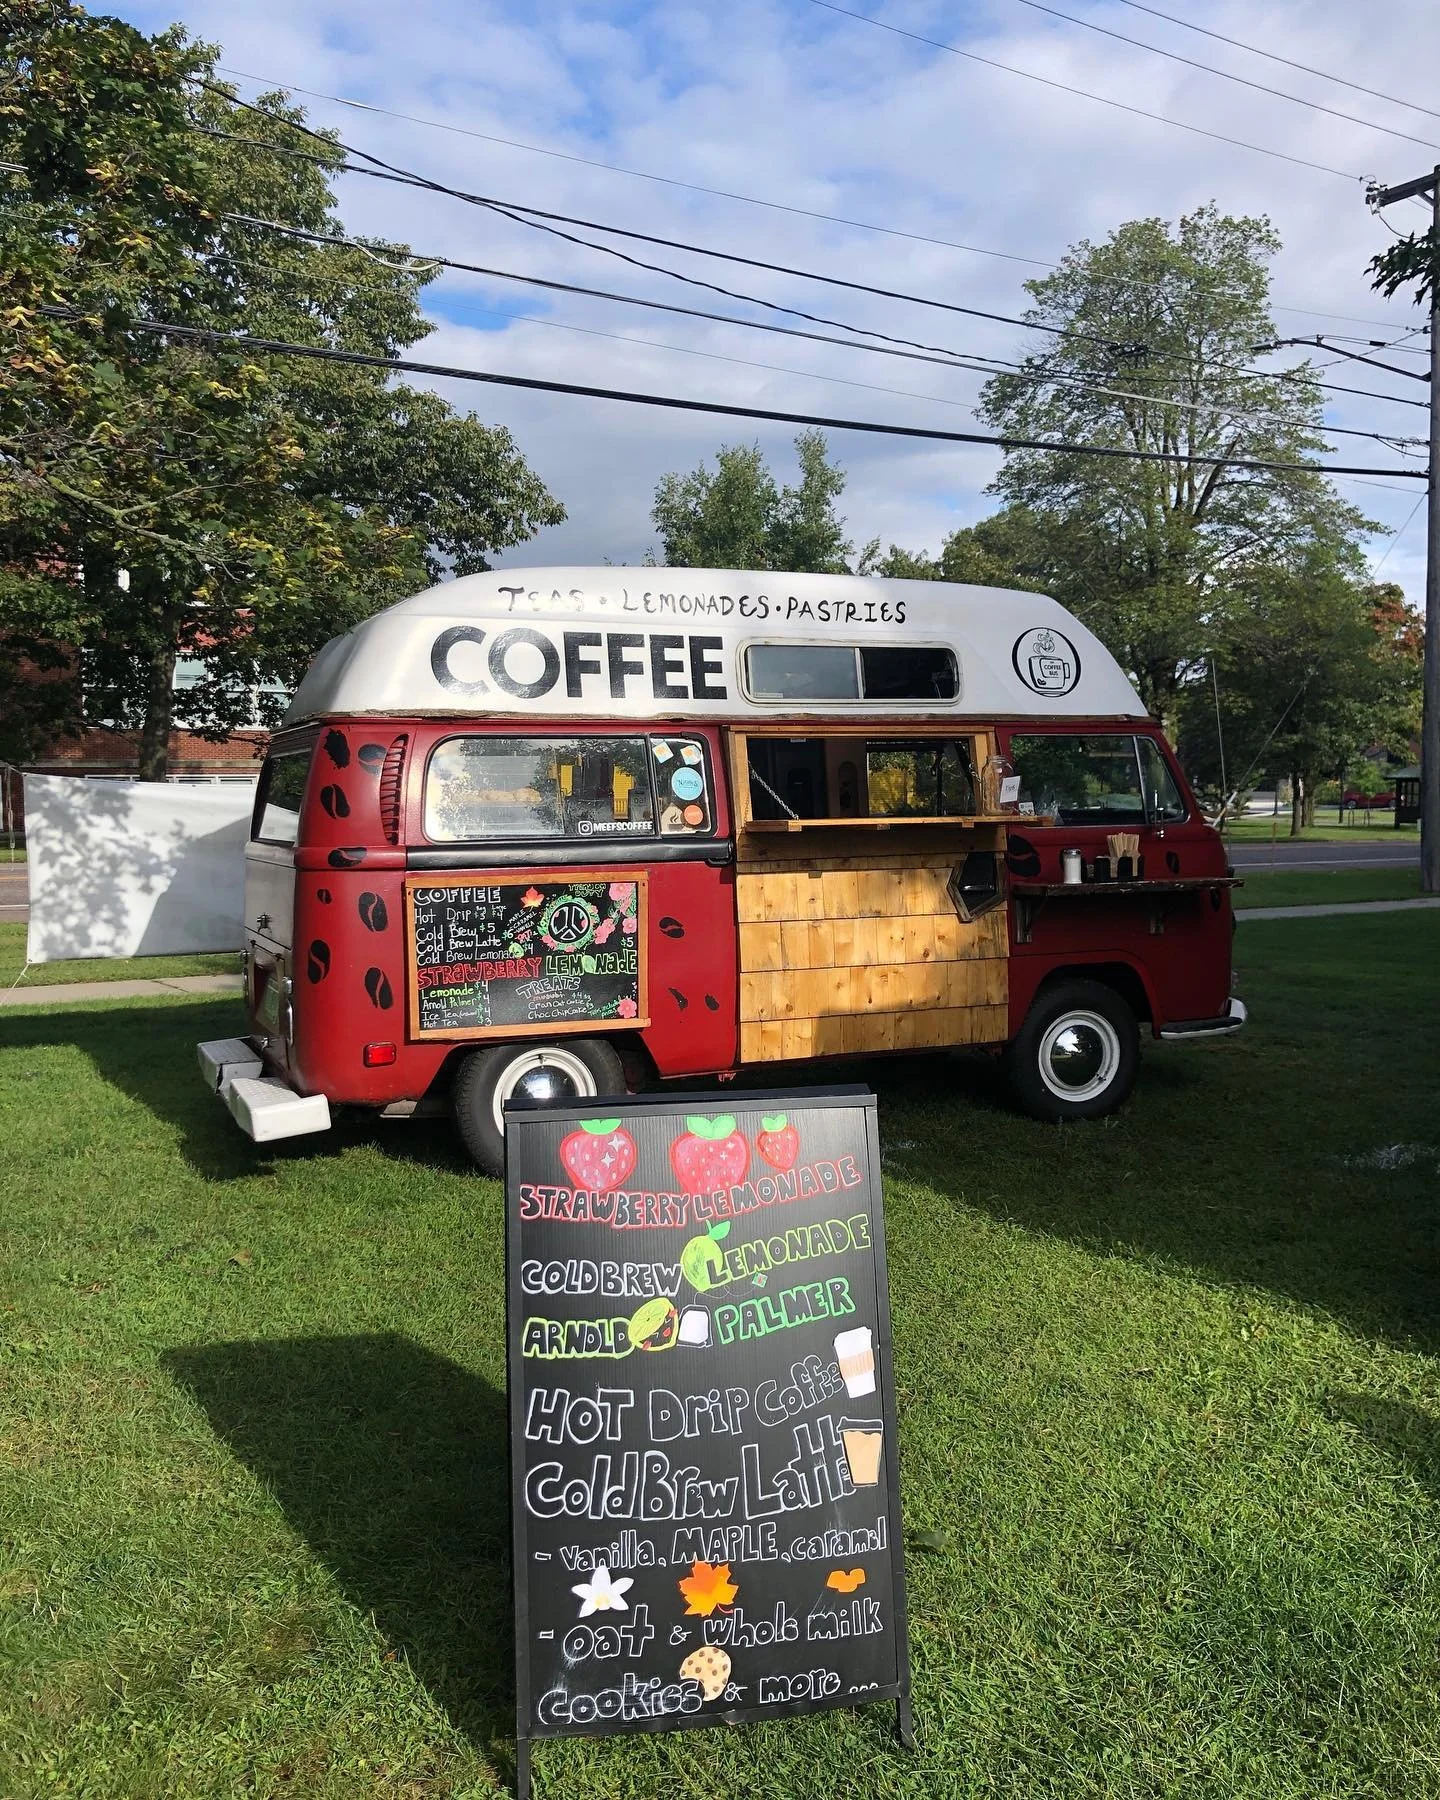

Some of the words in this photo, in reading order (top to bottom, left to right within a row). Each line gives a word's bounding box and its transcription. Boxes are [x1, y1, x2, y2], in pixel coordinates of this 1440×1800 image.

[623, 588, 769, 619] LEMONADES
[786, 597, 906, 624] PASTRIES
[430, 625, 727, 700] COFFEE
[593, 821, 653, 832] MEEFSCOFFEE
[413, 887, 501, 906] COFFEE
[415, 908, 437, 924] Hot
[446, 907, 471, 921] Drip
[415, 924, 444, 941] Cold
[449, 922, 477, 938] Brew
[620, 936, 634, 948] $5
[416, 938, 444, 955] Cold
[450, 938, 474, 950] Brew
[475, 934, 502, 947] Latte
[416, 951, 441, 966] Cold
[446, 950, 473, 963] Brew
[421, 983, 475, 999] Lemonade
[515, 975, 581, 1000] TREATS
[421, 1010, 441, 1021] Ice
[422, 1020, 438, 1028] Hot
[441, 1019, 459, 1027] Tea
[527, 1007, 551, 1019] Choc
[519, 1183, 690, 1229] STRAWBERRY
[692, 1155, 863, 1222] LEMONADE
[706, 1213, 872, 1285] LEMONADE
[522, 1317, 636, 1359] ARNOLD
[715, 1276, 857, 1345] PALMER
[524, 1388, 635, 1444] HOT
[754, 1355, 845, 1427] Coffee
[790, 1516, 886, 1560] caramel
[562, 1604, 655, 1661] oat
[669, 1625, 692, 1646] &
[703, 1602, 799, 1647] whole
[807, 1598, 883, 1641] milk
[759, 1668, 841, 1704] more
